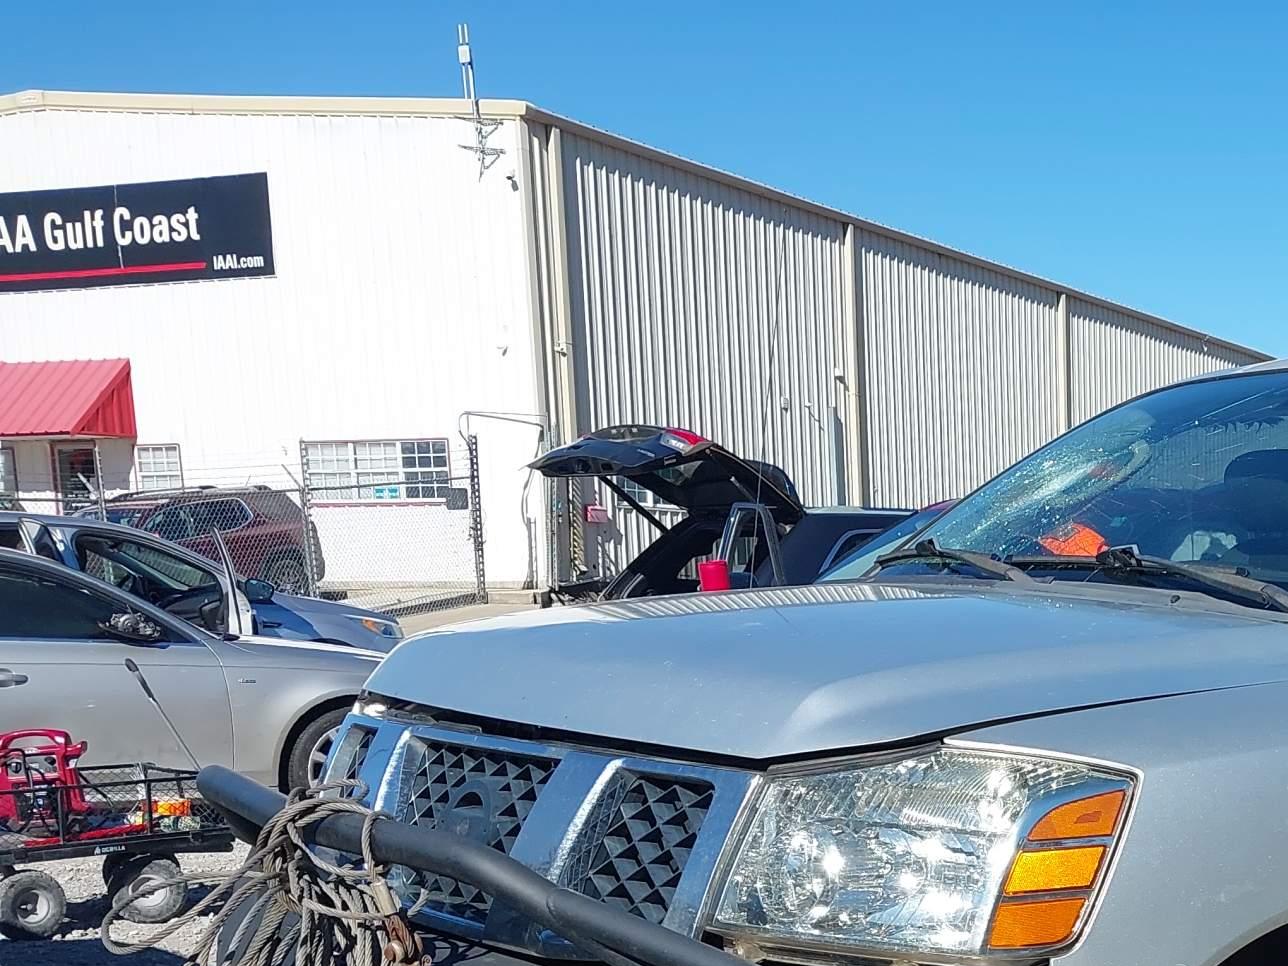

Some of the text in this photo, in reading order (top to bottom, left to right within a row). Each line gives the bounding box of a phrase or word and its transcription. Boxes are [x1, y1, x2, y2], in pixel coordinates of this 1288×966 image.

[43, 209, 105, 251] Gulf
[112, 205, 201, 247] Coast
[212, 254, 265, 271] IAAI.com
